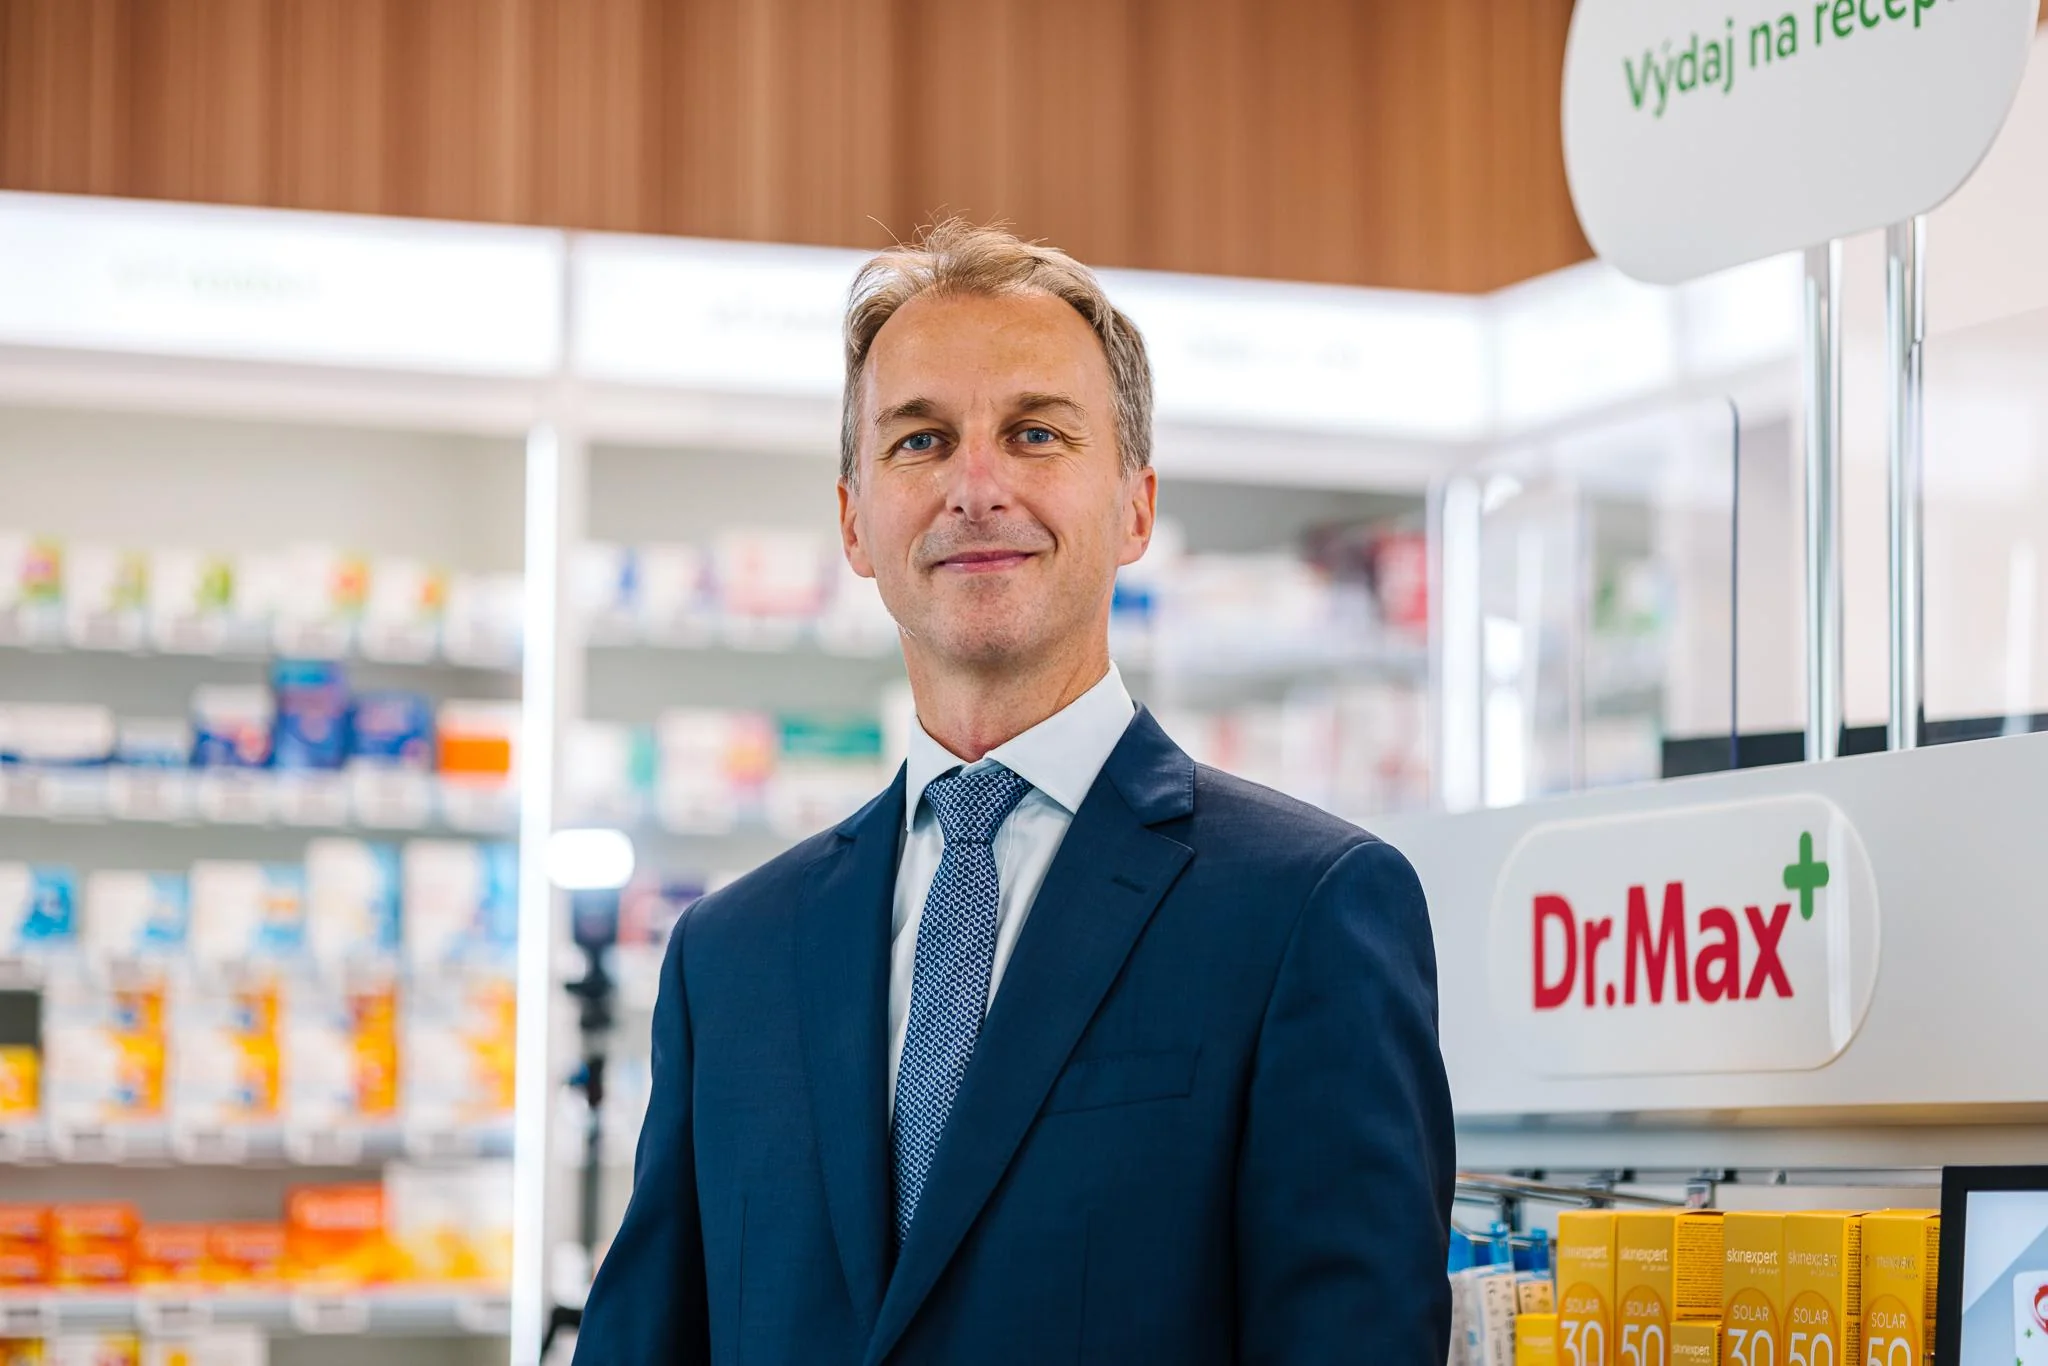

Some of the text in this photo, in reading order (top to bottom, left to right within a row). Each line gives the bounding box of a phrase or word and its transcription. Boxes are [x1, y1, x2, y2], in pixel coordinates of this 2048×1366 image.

[1622, 0, 1950, 119] Výdaj na recep
[1726, 1247, 1778, 1267] skinexpert
[1788, 1250, 1837, 1268] skinexpert
[1565, 1297, 1599, 1313] SOLAR
[1626, 1301, 1660, 1317] SOLAR
[1733, 1304, 1769, 1321] SOLAR
[1793, 1308, 1829, 1325] SOLAR
[1871, 1311, 1907, 1329] SOLAR
[1560, 1320, 1605, 1366] 30
[1620, 1324, 1665, 1366] 50
[1727, 1328, 1774, 1366] 30
